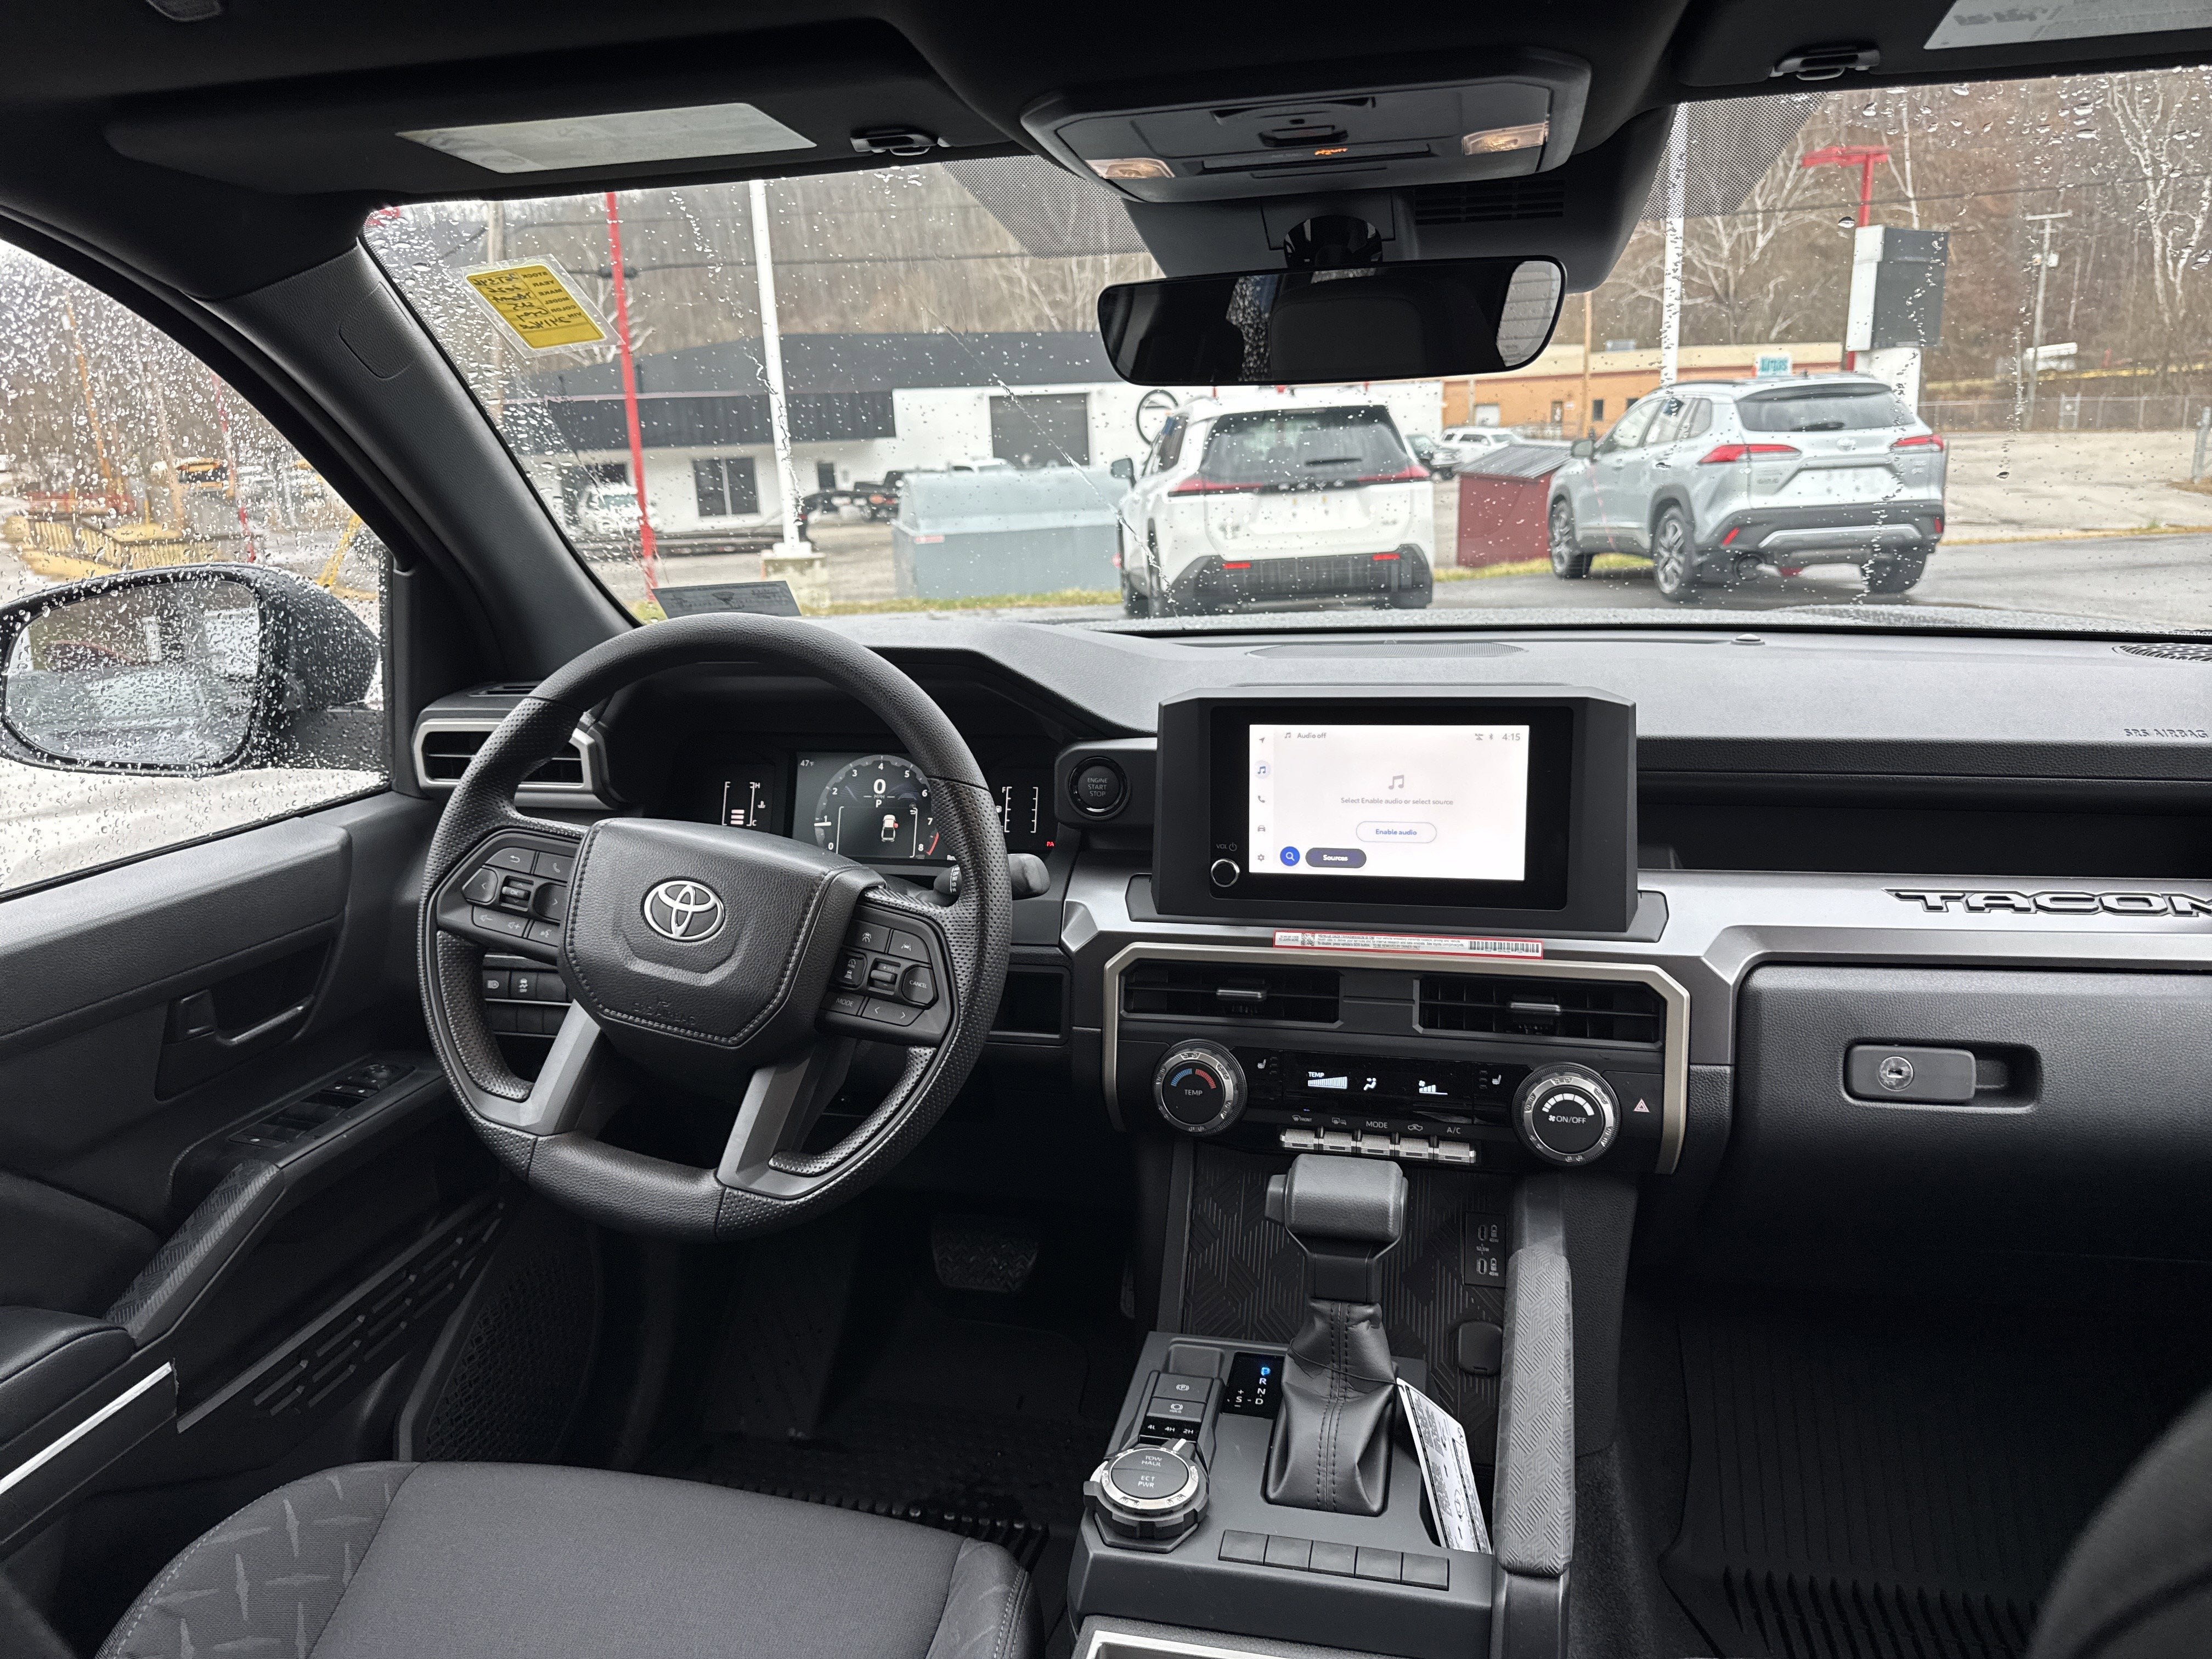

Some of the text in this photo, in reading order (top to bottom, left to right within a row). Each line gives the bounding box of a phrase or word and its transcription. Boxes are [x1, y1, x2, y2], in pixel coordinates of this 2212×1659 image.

[1502, 733, 1521, 741] 4:15
[2153, 729, 2209, 738] AIRBAG
[873, 778, 886, 794] 0
[876, 800, 882, 808] P
[1323, 854, 1348, 862] Sources
[836, 998, 854, 1007] MODE
[1556, 1116, 1587, 1125] ON/OFF
[1447, 1125, 1462, 1135] A/C
[1261, 1367, 1271, 1376] P
